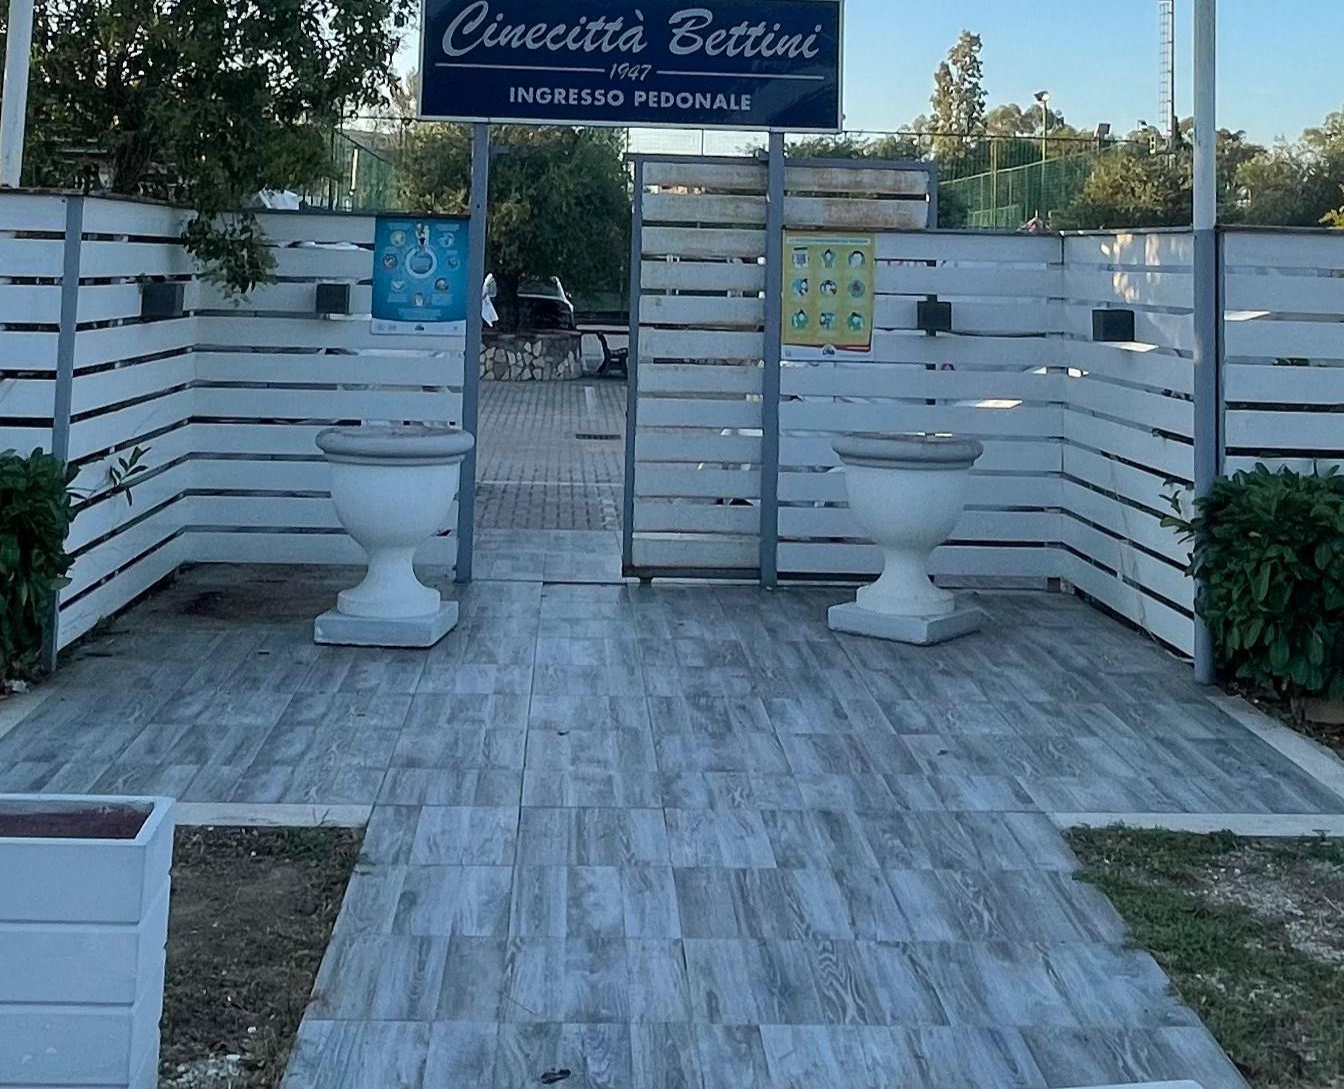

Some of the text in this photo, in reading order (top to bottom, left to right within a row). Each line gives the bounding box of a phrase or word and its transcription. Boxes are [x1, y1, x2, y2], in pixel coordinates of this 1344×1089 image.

[442, 0, 822, 59] Cinecittà Bettini
[609, 62, 652, 82] 1947
[509, 87, 751, 111] INGRESSO PEDONALE
